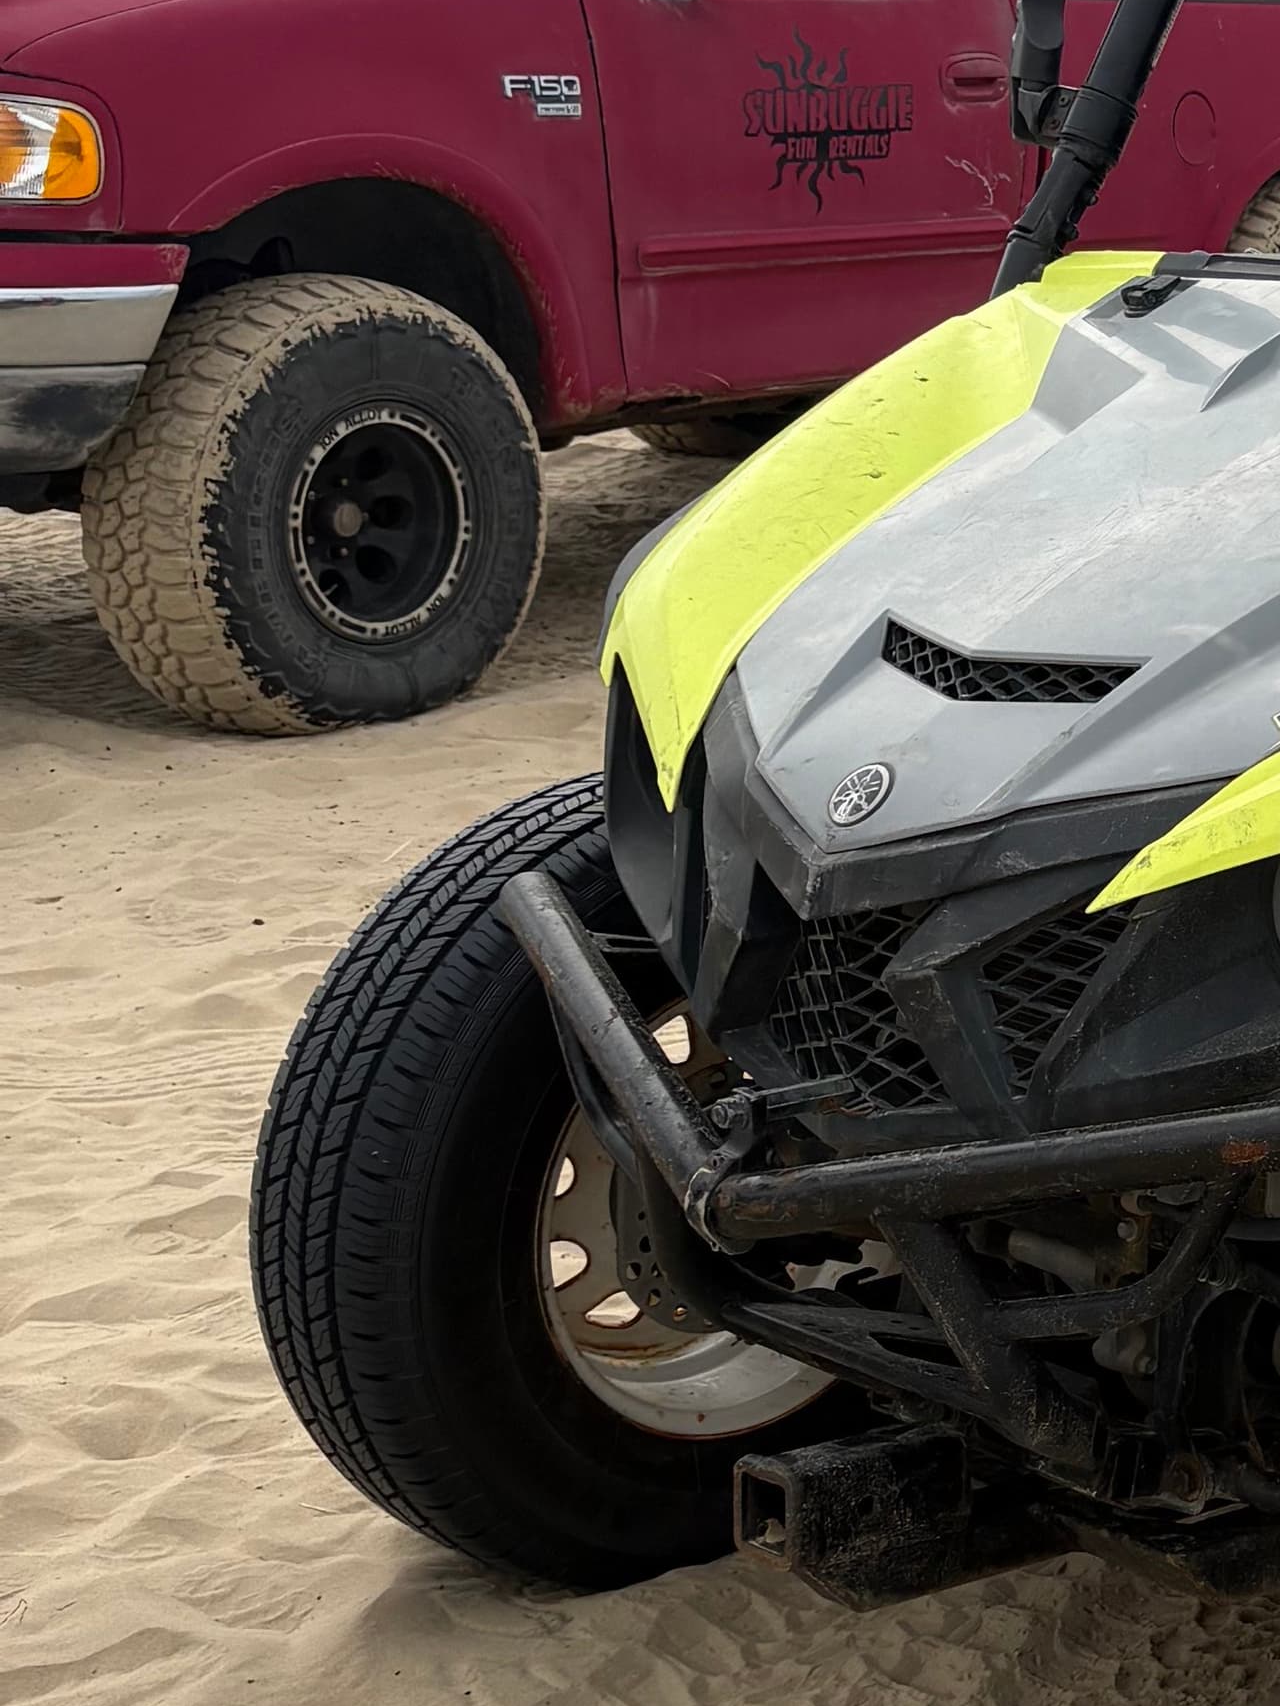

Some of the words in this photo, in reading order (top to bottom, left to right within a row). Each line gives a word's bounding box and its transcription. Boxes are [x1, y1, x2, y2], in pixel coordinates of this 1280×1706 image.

[743, 84, 913, 137] SUNBUGGIE
[787, 136, 817, 159] FUN
[828, 134, 890, 158] RENTALS
